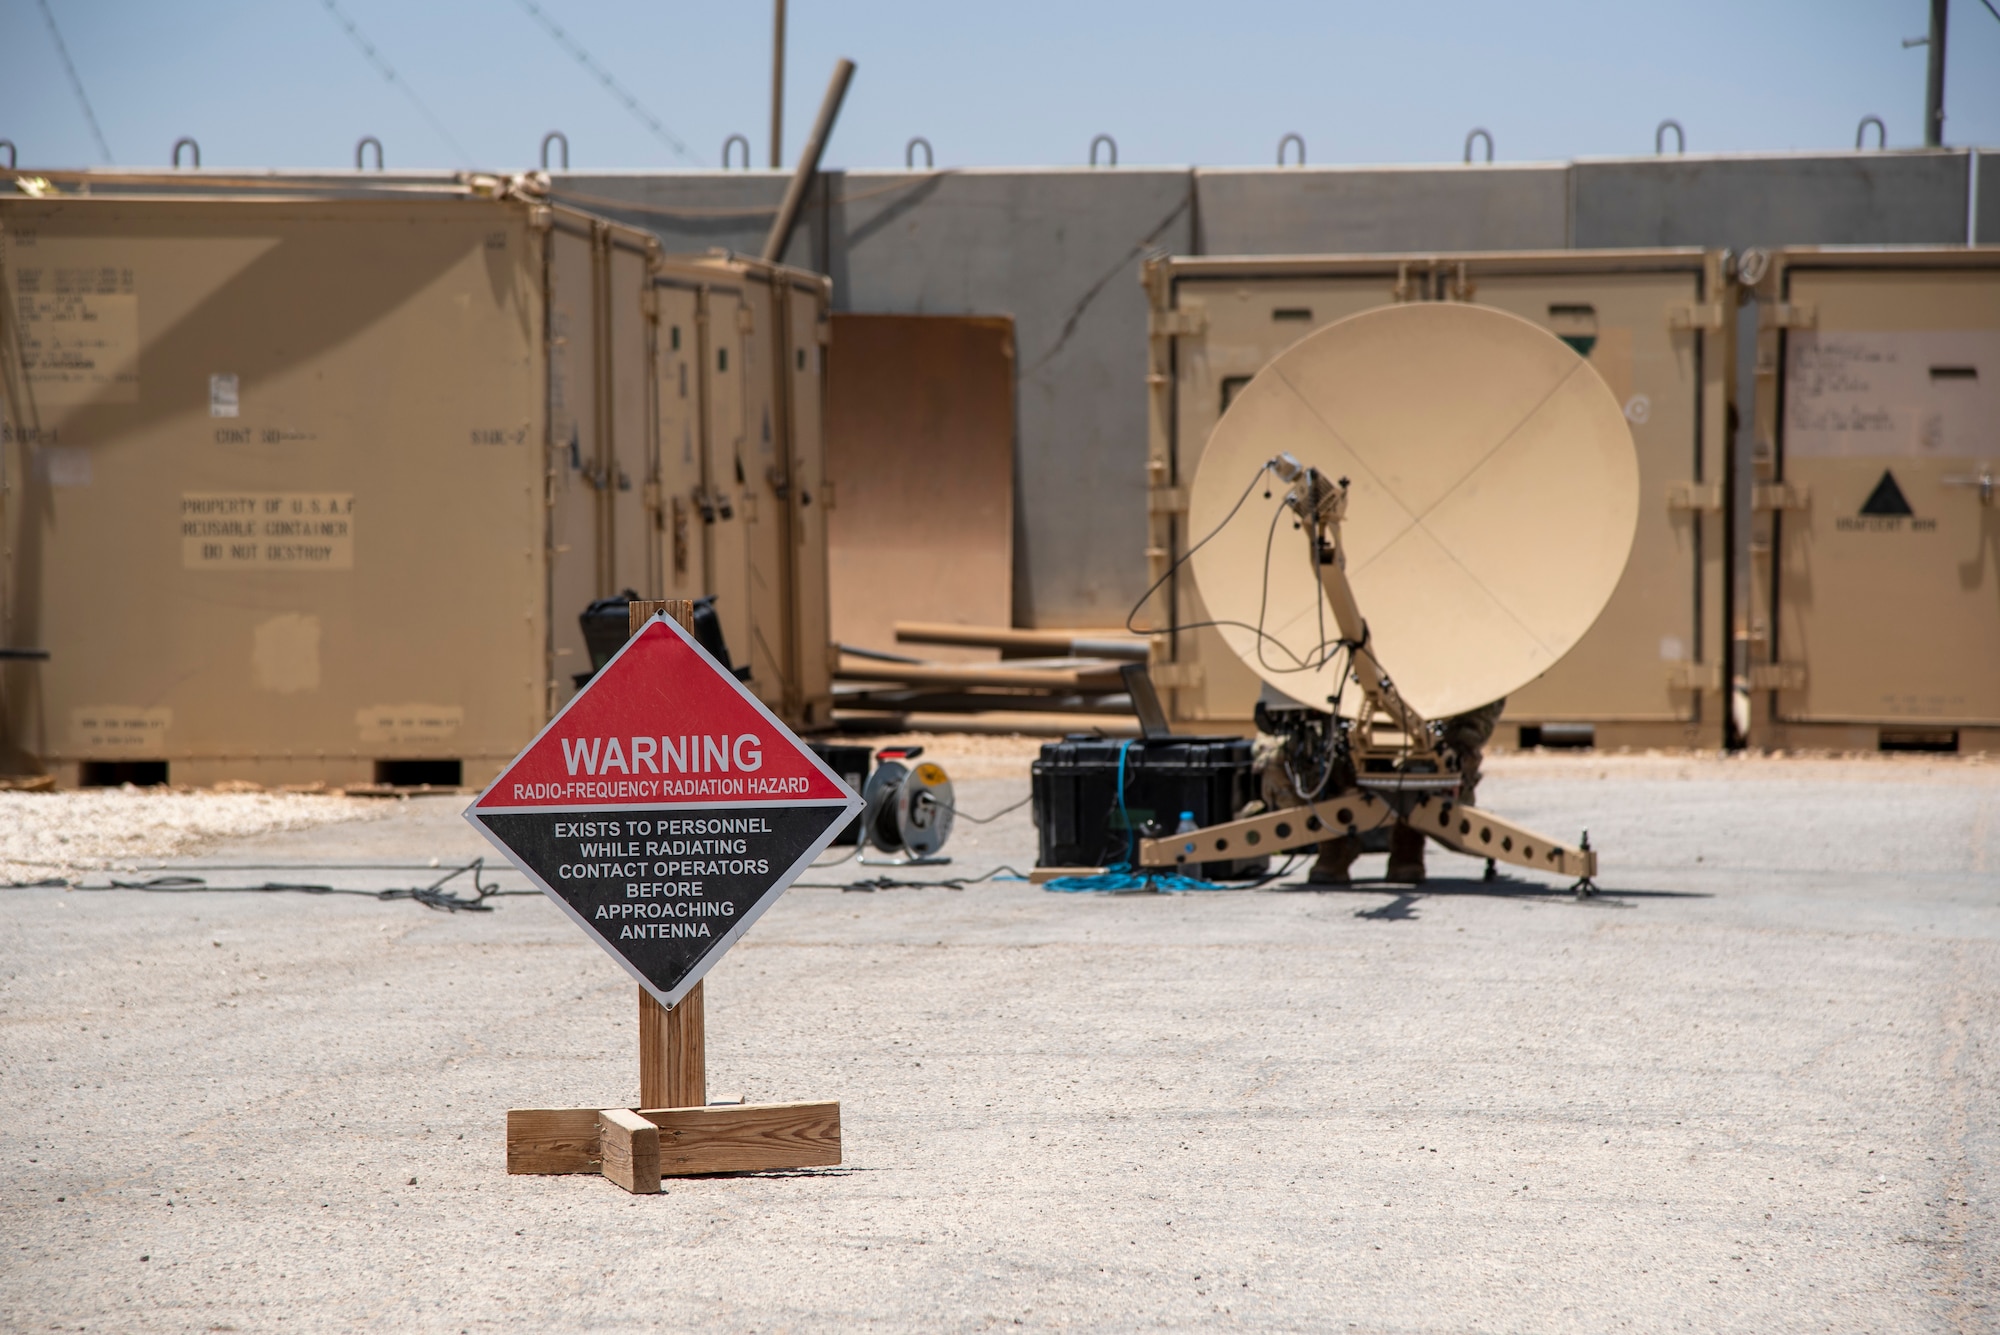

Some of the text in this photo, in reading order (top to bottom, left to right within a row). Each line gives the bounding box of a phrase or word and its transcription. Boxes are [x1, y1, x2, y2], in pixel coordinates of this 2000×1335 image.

[182, 498, 256, 514] PROPERTY
[265, 498, 282, 514] OF
[183, 520, 348, 537] REUSABLE CONTAINER
[203, 544, 332, 561] DO NOT DESTROY
[560, 734, 763, 776] WARNING
[513, 777, 810, 800] RADIO-FREQUENCY RADIATION HAZARD
[555, 818, 772, 838] EXISTS TO PERSONNEL
[579, 839, 747, 858] WHILE RADIATING
[558, 859, 769, 879] CONTACT OPERATORS
[626, 881, 703, 898] BEFORE
[595, 901, 735, 919] APPROACHING
[619, 922, 711, 940] ANTENNA
